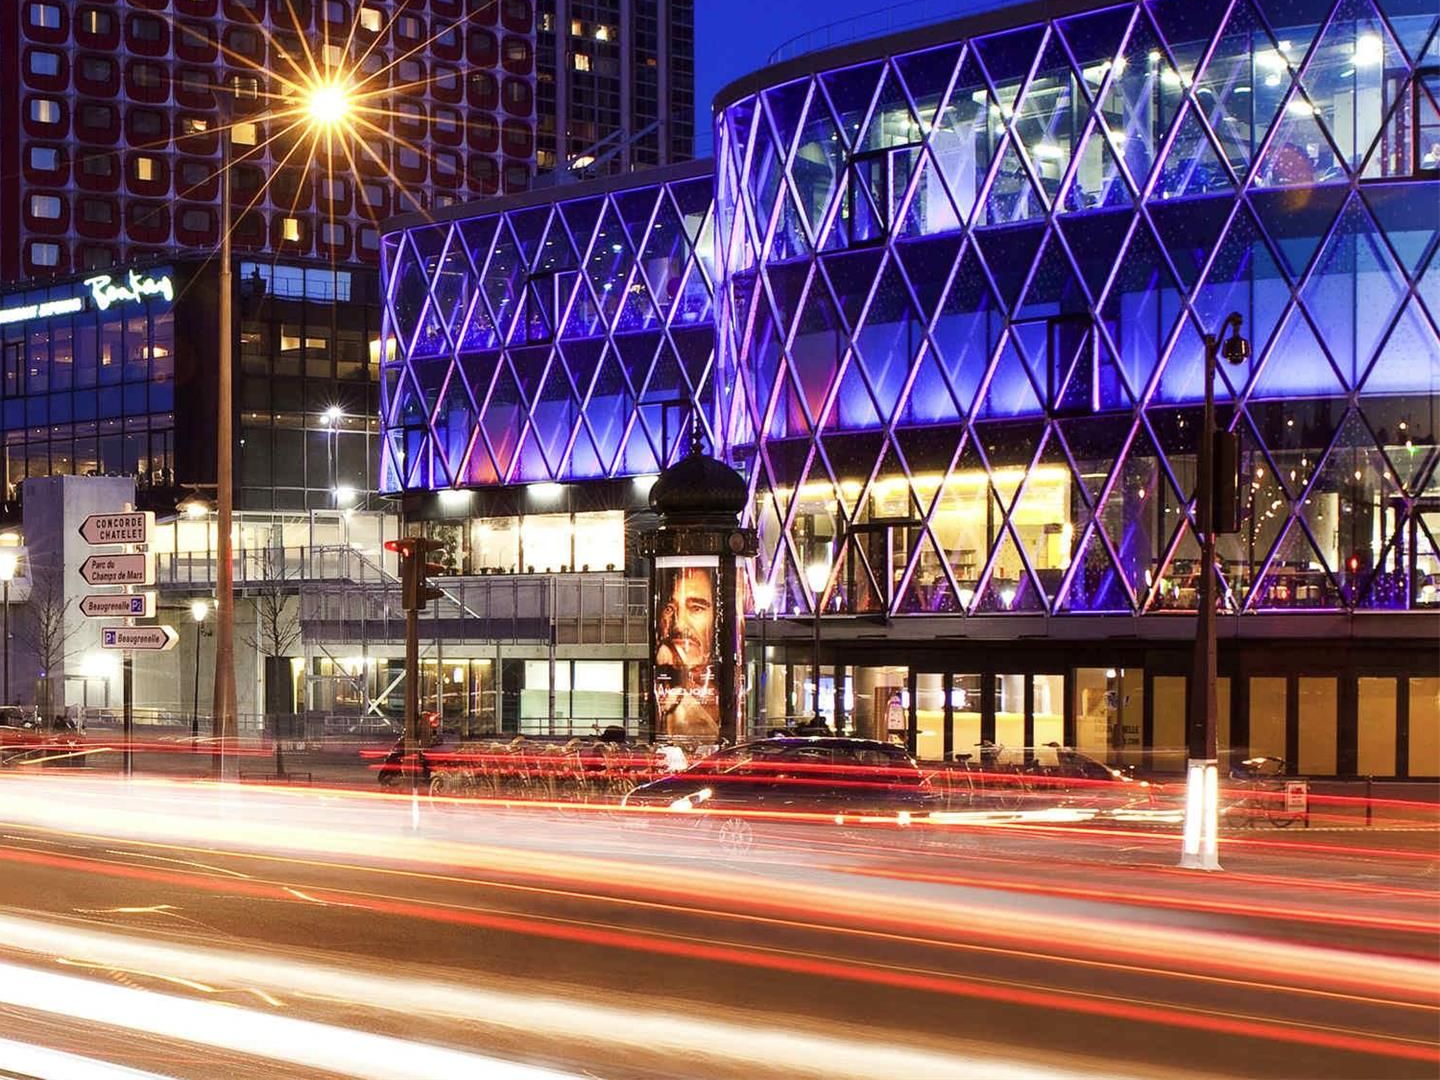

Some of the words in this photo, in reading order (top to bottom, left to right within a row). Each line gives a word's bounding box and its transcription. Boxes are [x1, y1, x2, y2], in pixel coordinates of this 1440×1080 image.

[96, 517, 142, 528] CONCORDE
[100, 529, 142, 540] CHATELET
[91, 560, 106, 569] Parc
[107, 560, 115, 569] du
[92, 571, 116, 581] Champs
[117, 571, 125, 580] de
[127, 570, 143, 580] Mars
[88, 601, 130, 612] Beaugrenelle
[132, 600, 142, 611] P2
[117, 633, 160, 645] Beaugrenelle
